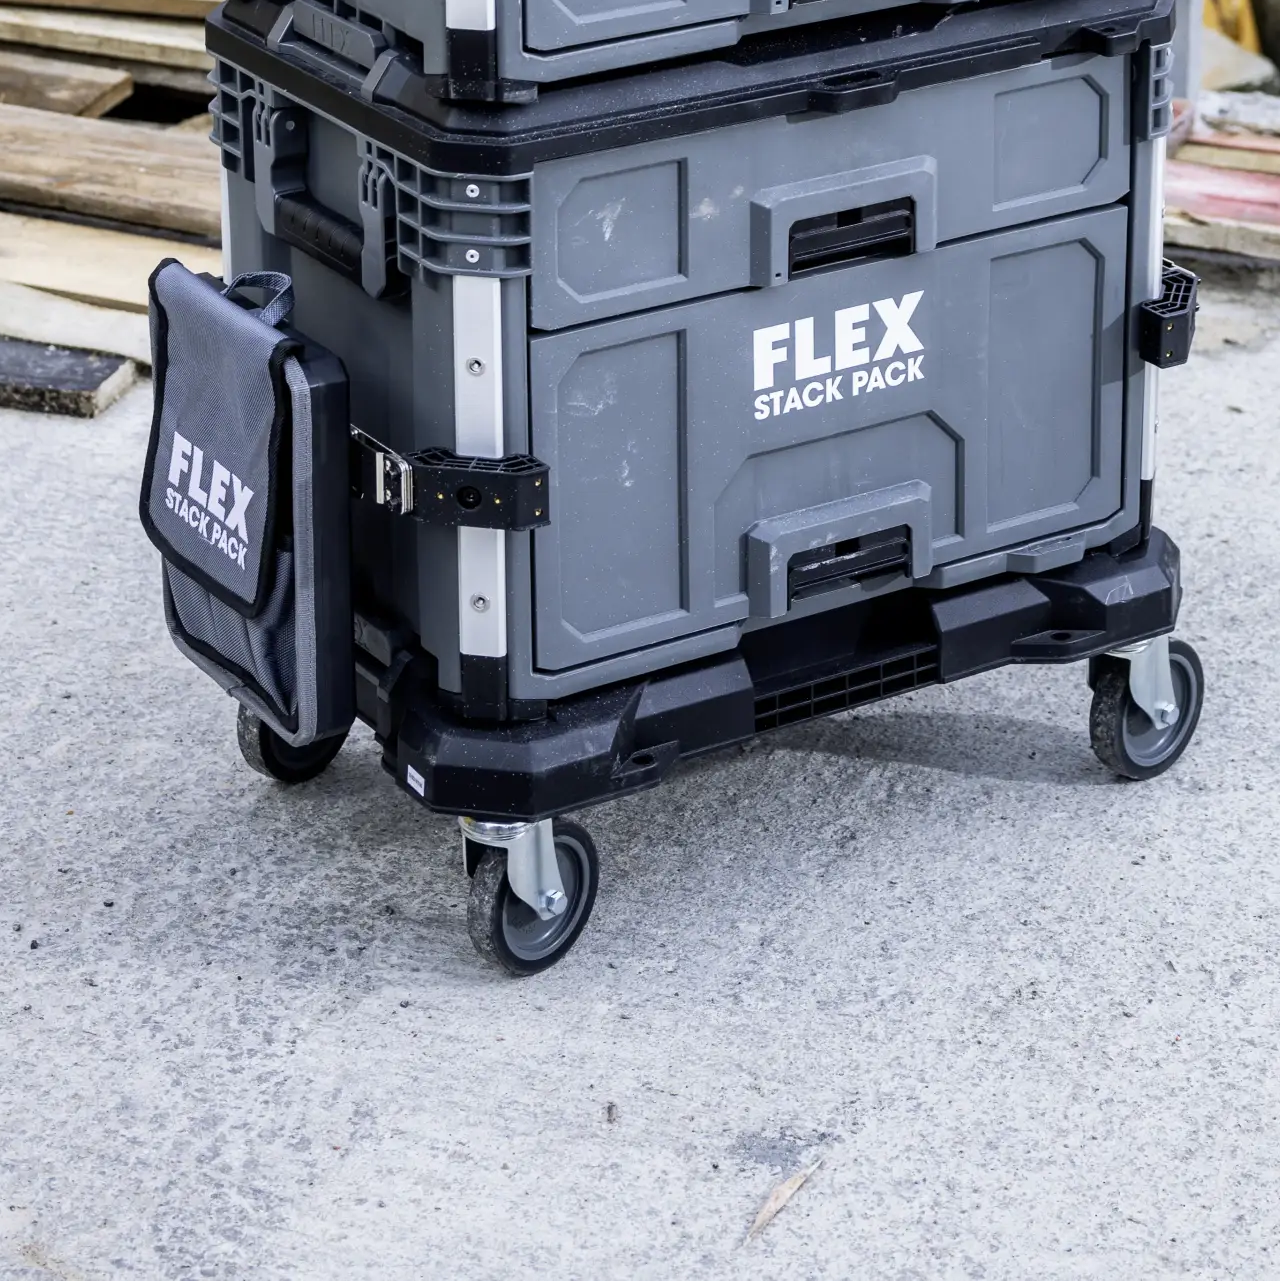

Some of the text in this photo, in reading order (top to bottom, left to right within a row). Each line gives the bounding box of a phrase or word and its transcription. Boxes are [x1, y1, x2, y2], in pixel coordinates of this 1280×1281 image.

[753, 290, 925, 392] FLEX
[754, 355, 925, 420] STACK PACK
[165, 487, 247, 570] STACK PACK
[168, 430, 254, 544] FLEX
